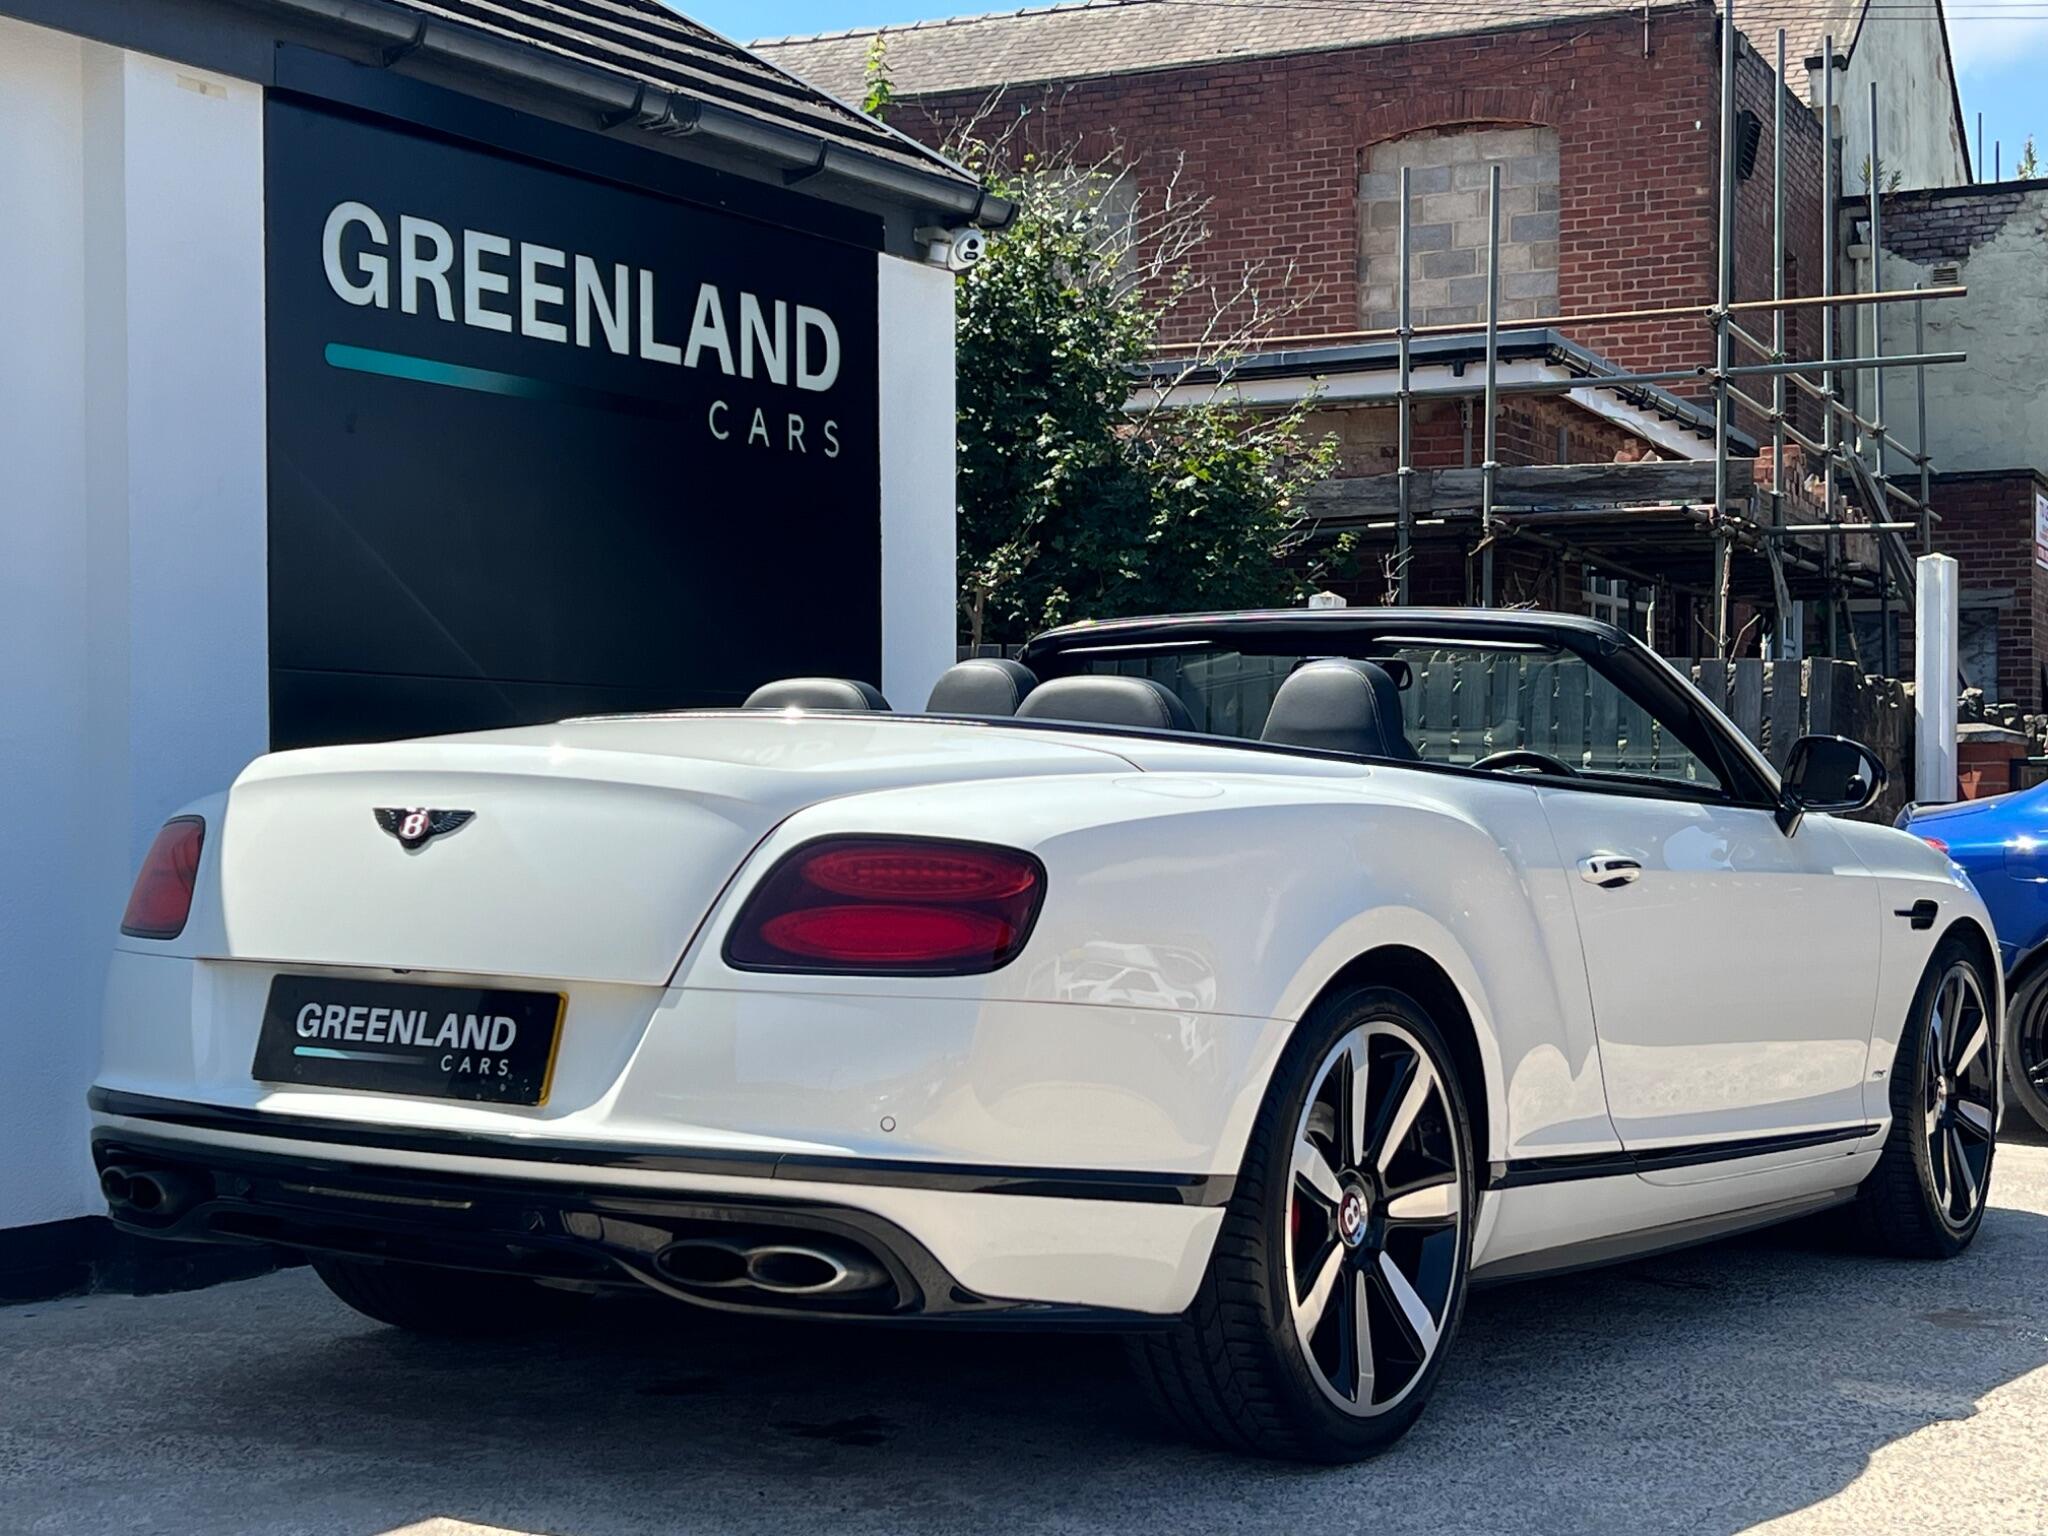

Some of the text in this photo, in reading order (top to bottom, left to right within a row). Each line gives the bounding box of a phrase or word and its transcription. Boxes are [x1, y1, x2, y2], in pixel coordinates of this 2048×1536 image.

[322, 201, 841, 392] GREENLAND
[708, 400, 840, 458] CARS
[296, 1002, 517, 1052] GREENLAND
[440, 1055, 510, 1076] CARS
